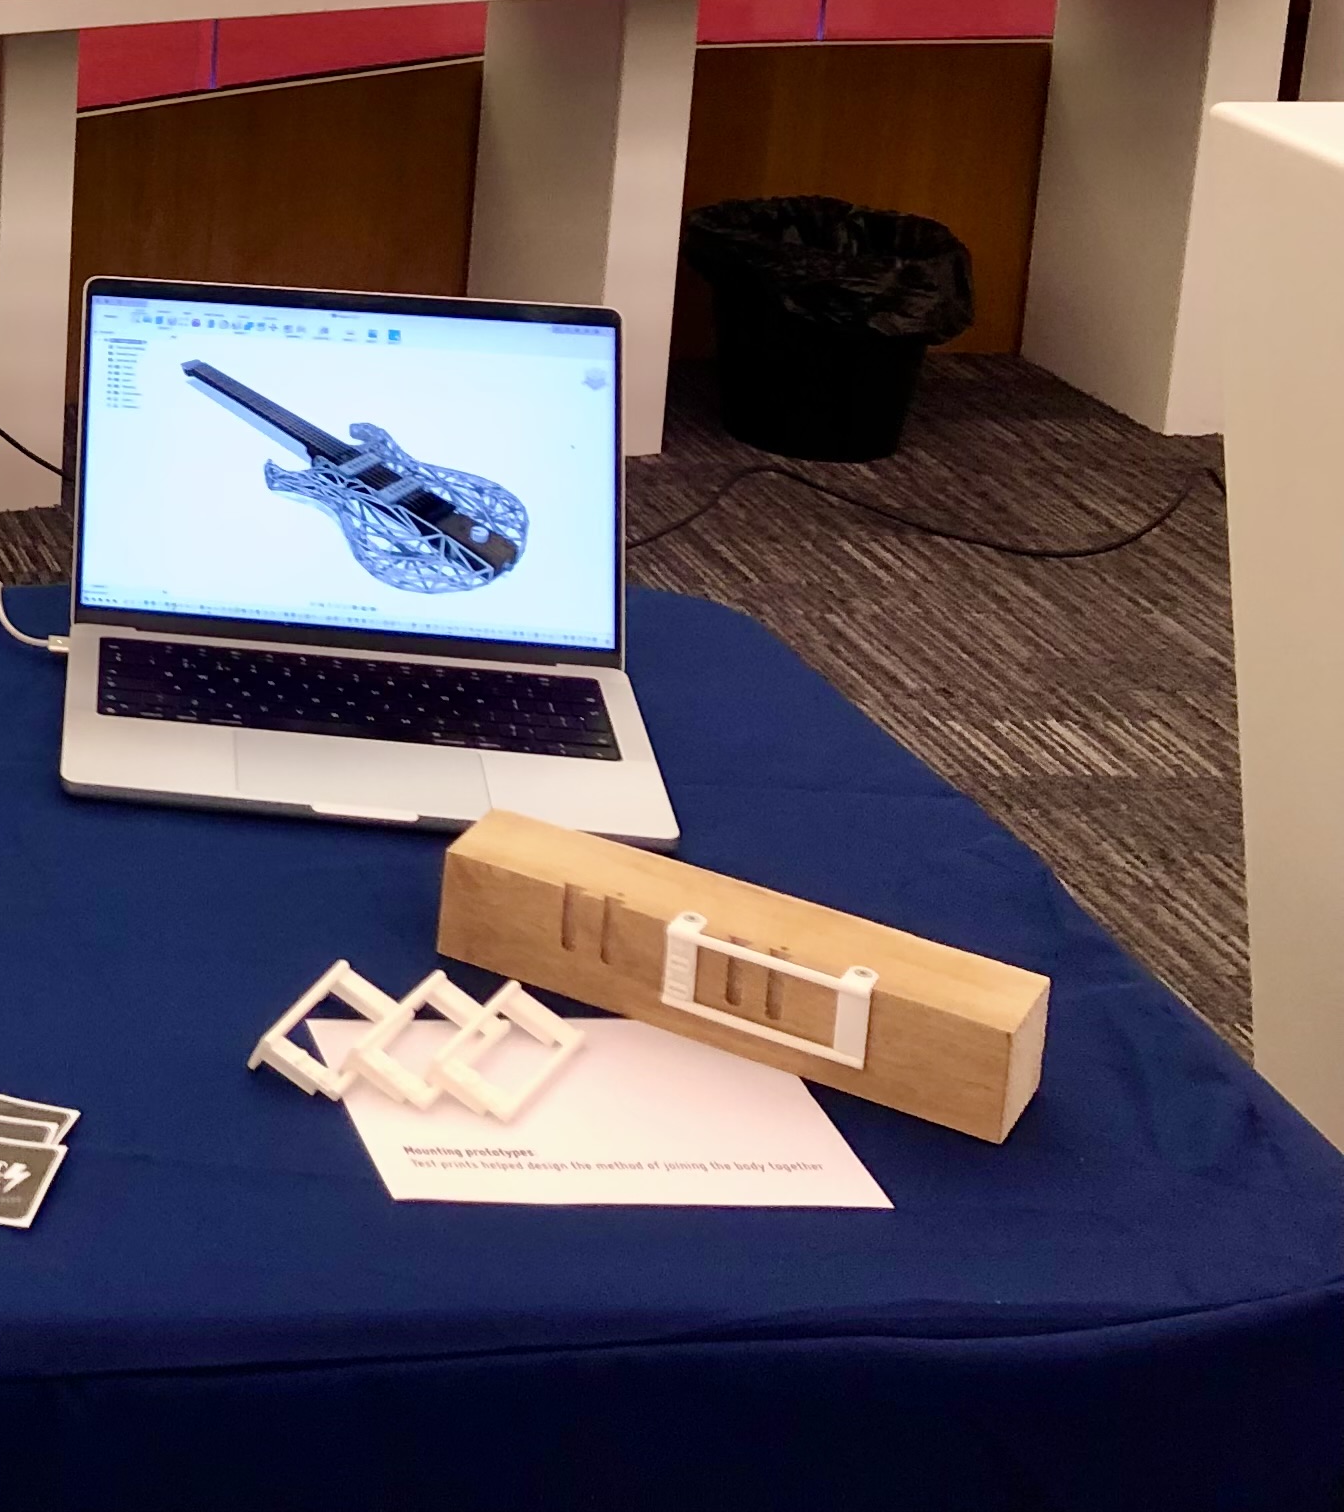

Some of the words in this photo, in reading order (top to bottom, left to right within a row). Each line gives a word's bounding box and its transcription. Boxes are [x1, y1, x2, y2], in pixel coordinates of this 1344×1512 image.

[402, 1145, 464, 1158] Mounting
[410, 1158, 437, 1169] Test
[440, 1159, 479, 1171] prints
[480, 1160, 525, 1172] helped
[527, 1160, 569, 1172] design
[570, 1160, 592, 1171] the
[595, 1160, 644, 1171] method
[647, 1160, 660, 1171] of
[664, 1161, 709, 1173] joining
[709, 1160, 732, 1171] the
[733, 1160, 766, 1173] body
[768, 1161, 824, 1173] together
